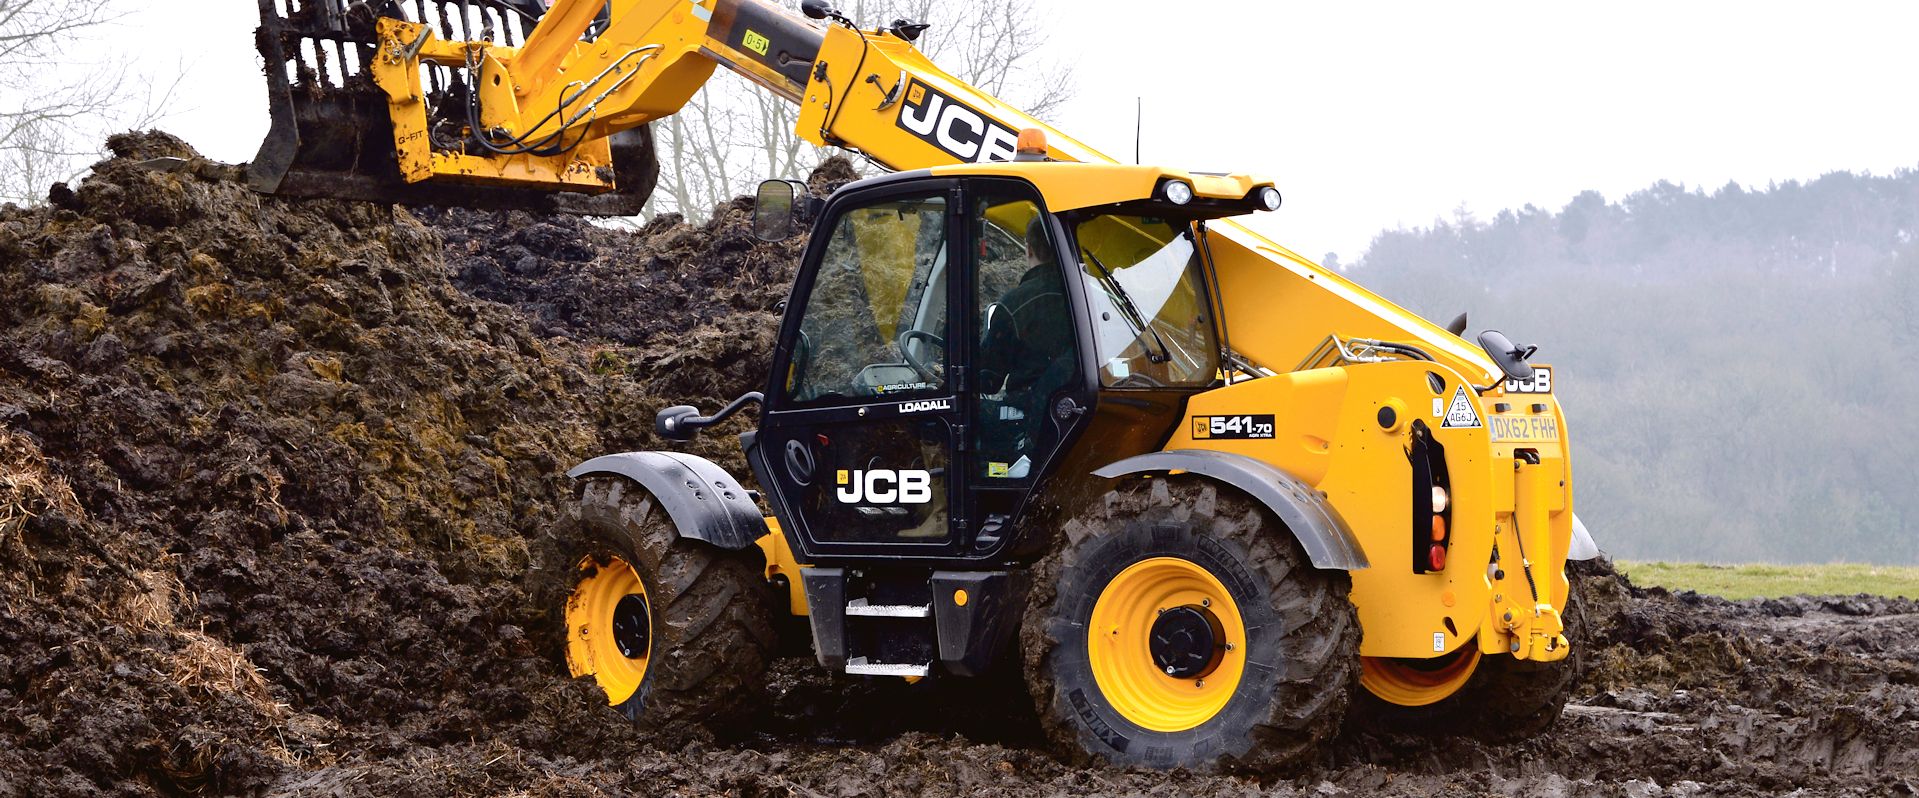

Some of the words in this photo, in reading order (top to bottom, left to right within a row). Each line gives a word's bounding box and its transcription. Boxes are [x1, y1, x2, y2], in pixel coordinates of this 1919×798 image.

[901, 93, 1018, 163] JCB
[883, 382, 926, 391] AGRICULTURE
[899, 400, 951, 413] LOADALL
[1456, 402, 1467, 411] 15
[1450, 412, 1472, 422] AG6J
[1495, 418, 1530, 439] DX62
[1531, 418, 1557, 439] FHH
[837, 469, 932, 504] JCB
